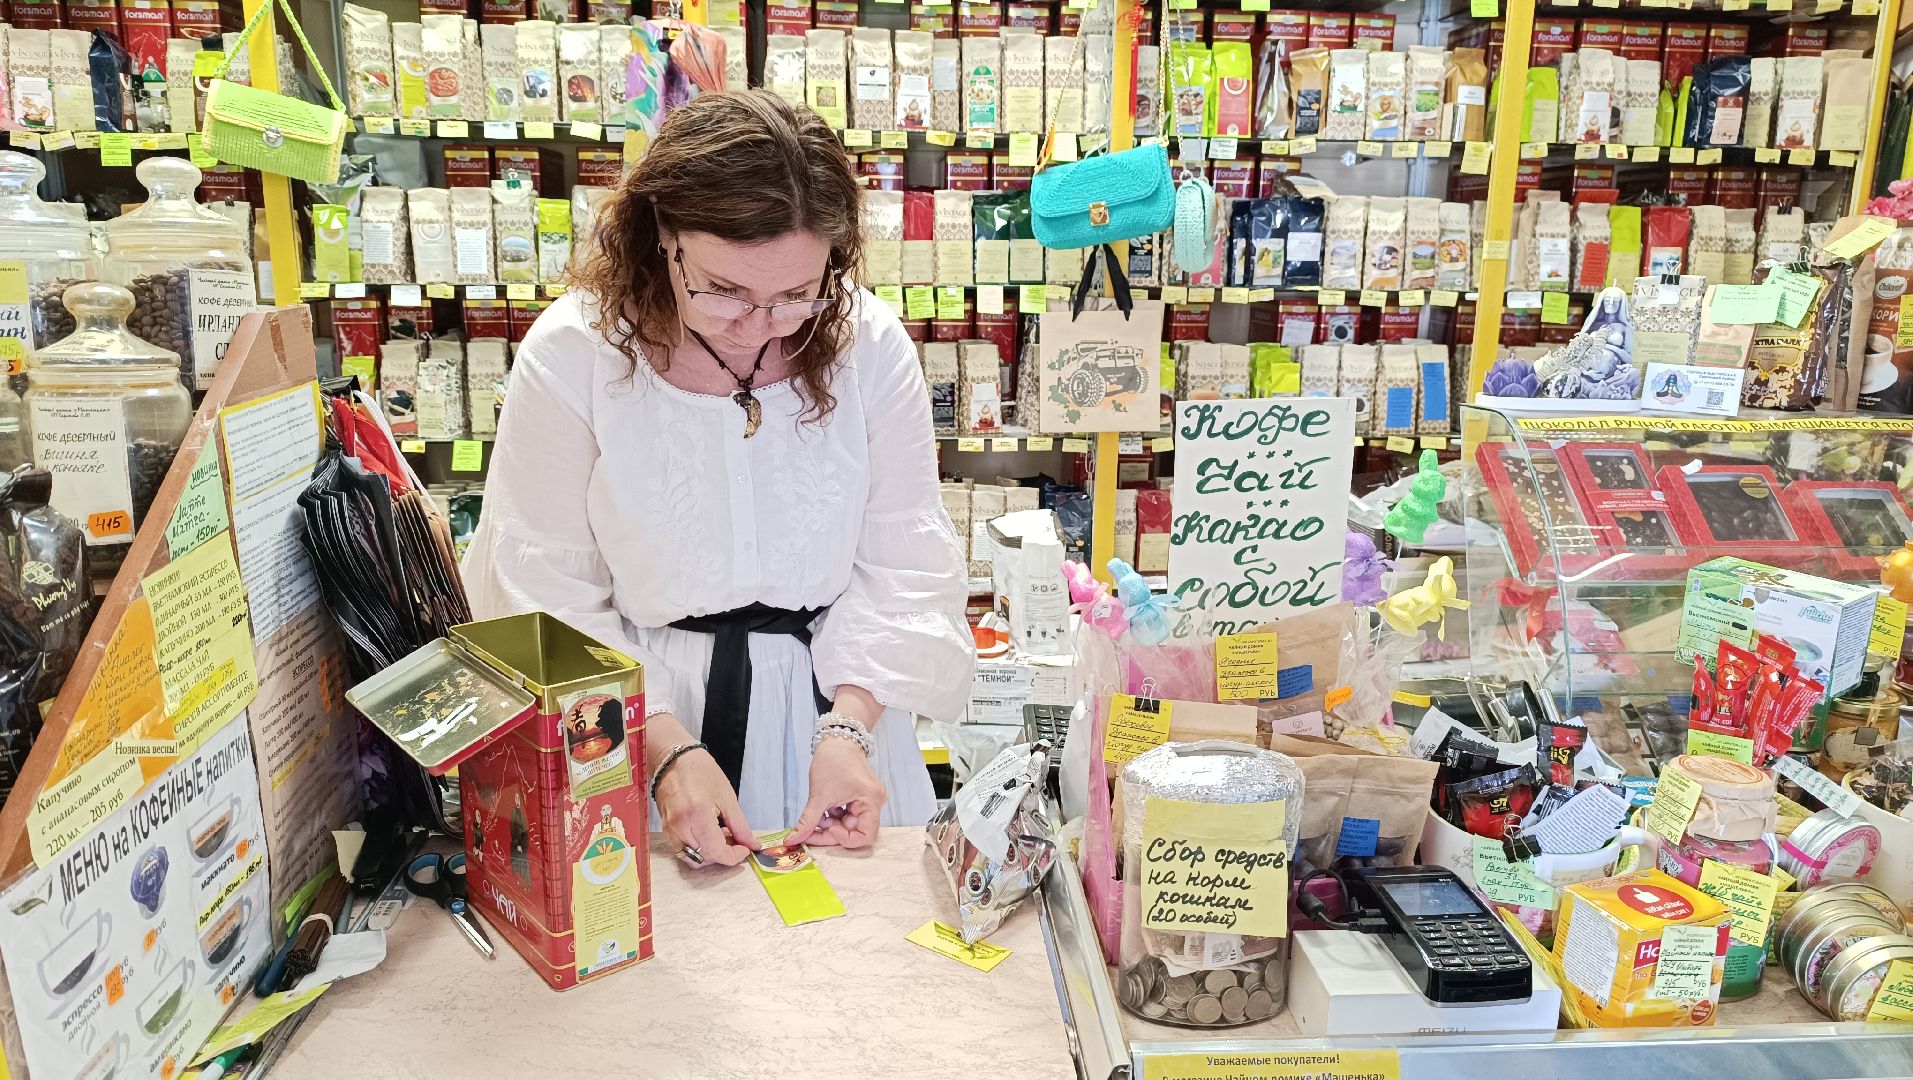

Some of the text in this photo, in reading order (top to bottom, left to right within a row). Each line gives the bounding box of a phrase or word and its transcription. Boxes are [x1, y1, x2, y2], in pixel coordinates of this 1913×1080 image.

[125, 10, 165, 20] forsman
[1270, 24, 1305, 34] forsman
[1313, 26, 1348, 36] forsman
[1538, 32, 1571, 43] forsman
[198, 297, 221, 306] КОФЕ
[336, 310, 374, 319] forsman
[1180, 403, 1331, 446] Кофе
[1524, 418, 1611, 431] ШОКОЛАД
[1614, 416, 1678, 430] РУЧНОЙ
[1886, 421, 1913, 431] ТРО
[37, 431, 116, 445] КОФЕ ДЕСЕРТНЫЙ
[192, 460, 217, 483] НОВИНКА
[1195, 456, 1332, 494] Чай
[95, 516, 123, 531] 415
[1170, 511, 1325, 546] Какао
[153, 559, 228, 612] ВЬЕТНАМСКИЙ ЭСПРЕССО
[155, 594, 193, 627] ОДИНАРНЫЙ
[158, 614, 187, 644] ДВОЙНОЙ
[115, 741, 178, 754] Новинка весны!
[37, 774, 82, 814] Капучино
[48, 783, 101, 832] ананасовым
[101, 757, 136, 788] сиропом
[45, 789, 124, 857] 220 мл 205 руб
[60, 831, 109, 906] МЕНЮ
[112, 826, 129, 863] на
[130, 756, 203, 846] КОФЕЙНЫЕ
[205, 731, 250, 788] напитки
[1146, 838, 1285, 874] Сбор средств
[1148, 869, 1251, 892] на корм
[491, 887, 518, 927] ЧАЙ
[1156, 890, 1253, 911] кошкам
[1518, 893, 1535, 903] РУБ
[1147, 905, 1237, 929] (20 особей)
[1740, 932, 1759, 943] РУБ
[62, 983, 103, 1032] эспрессо
[150, 1018, 192, 1073] американо
[1206, 1054, 1340, 1067] Уважаемые покупатели!
